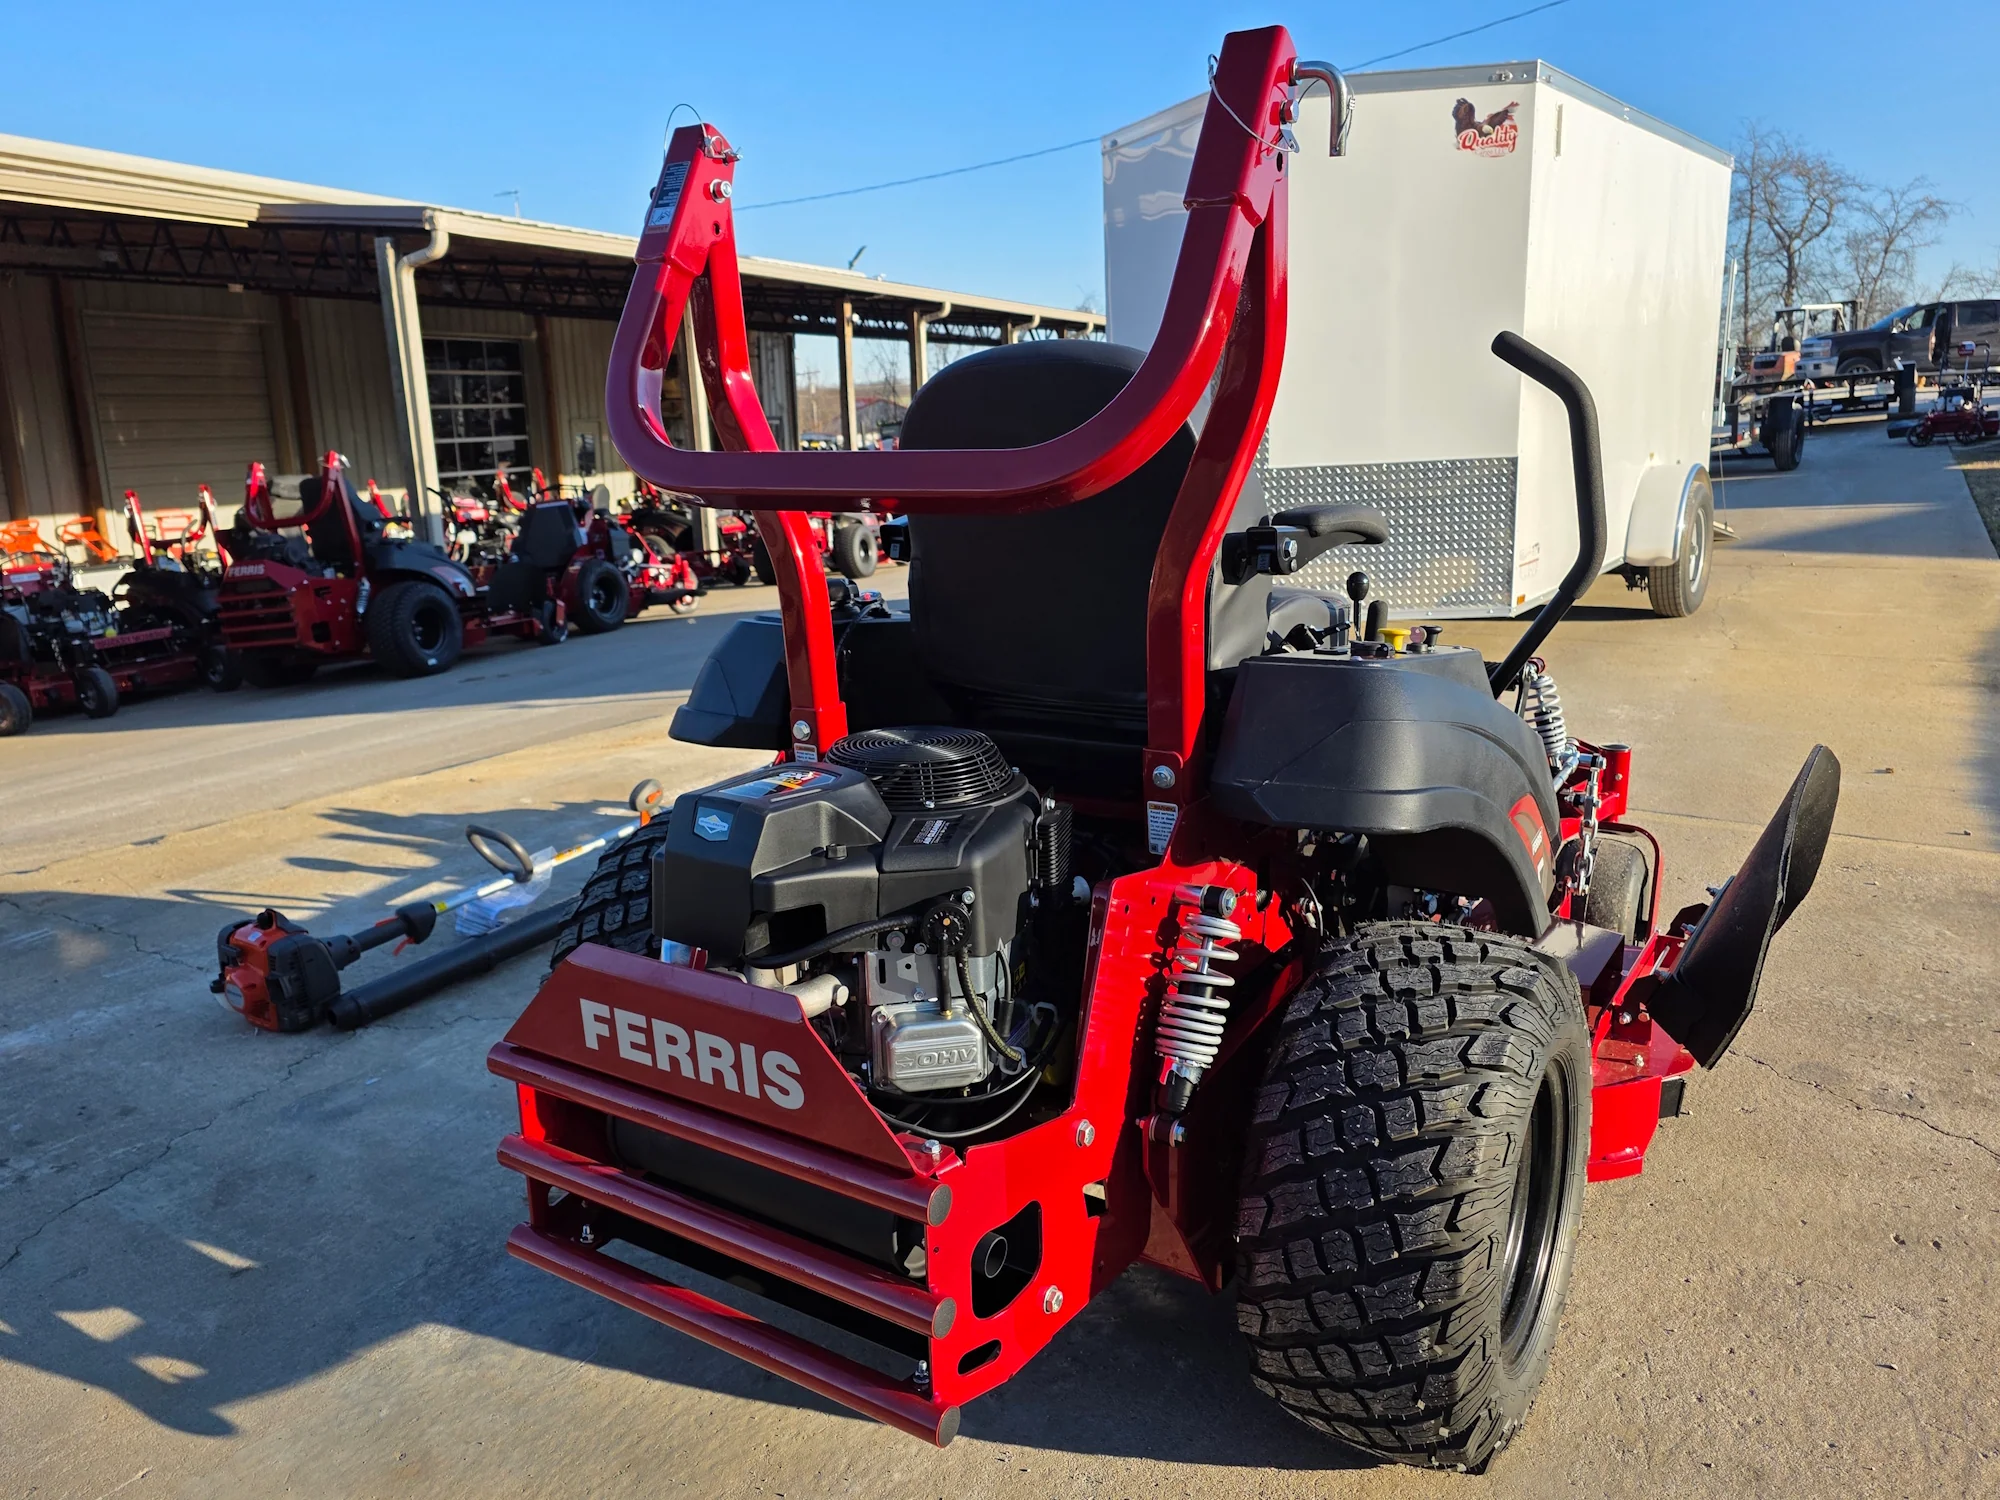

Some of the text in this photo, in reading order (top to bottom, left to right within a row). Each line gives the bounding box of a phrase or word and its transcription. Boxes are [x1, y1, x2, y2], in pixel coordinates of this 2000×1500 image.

[1458, 126, 1517, 153] Quality
[579, 998, 804, 1110] FERRIS
[917, 1047, 977, 1067] OHV
